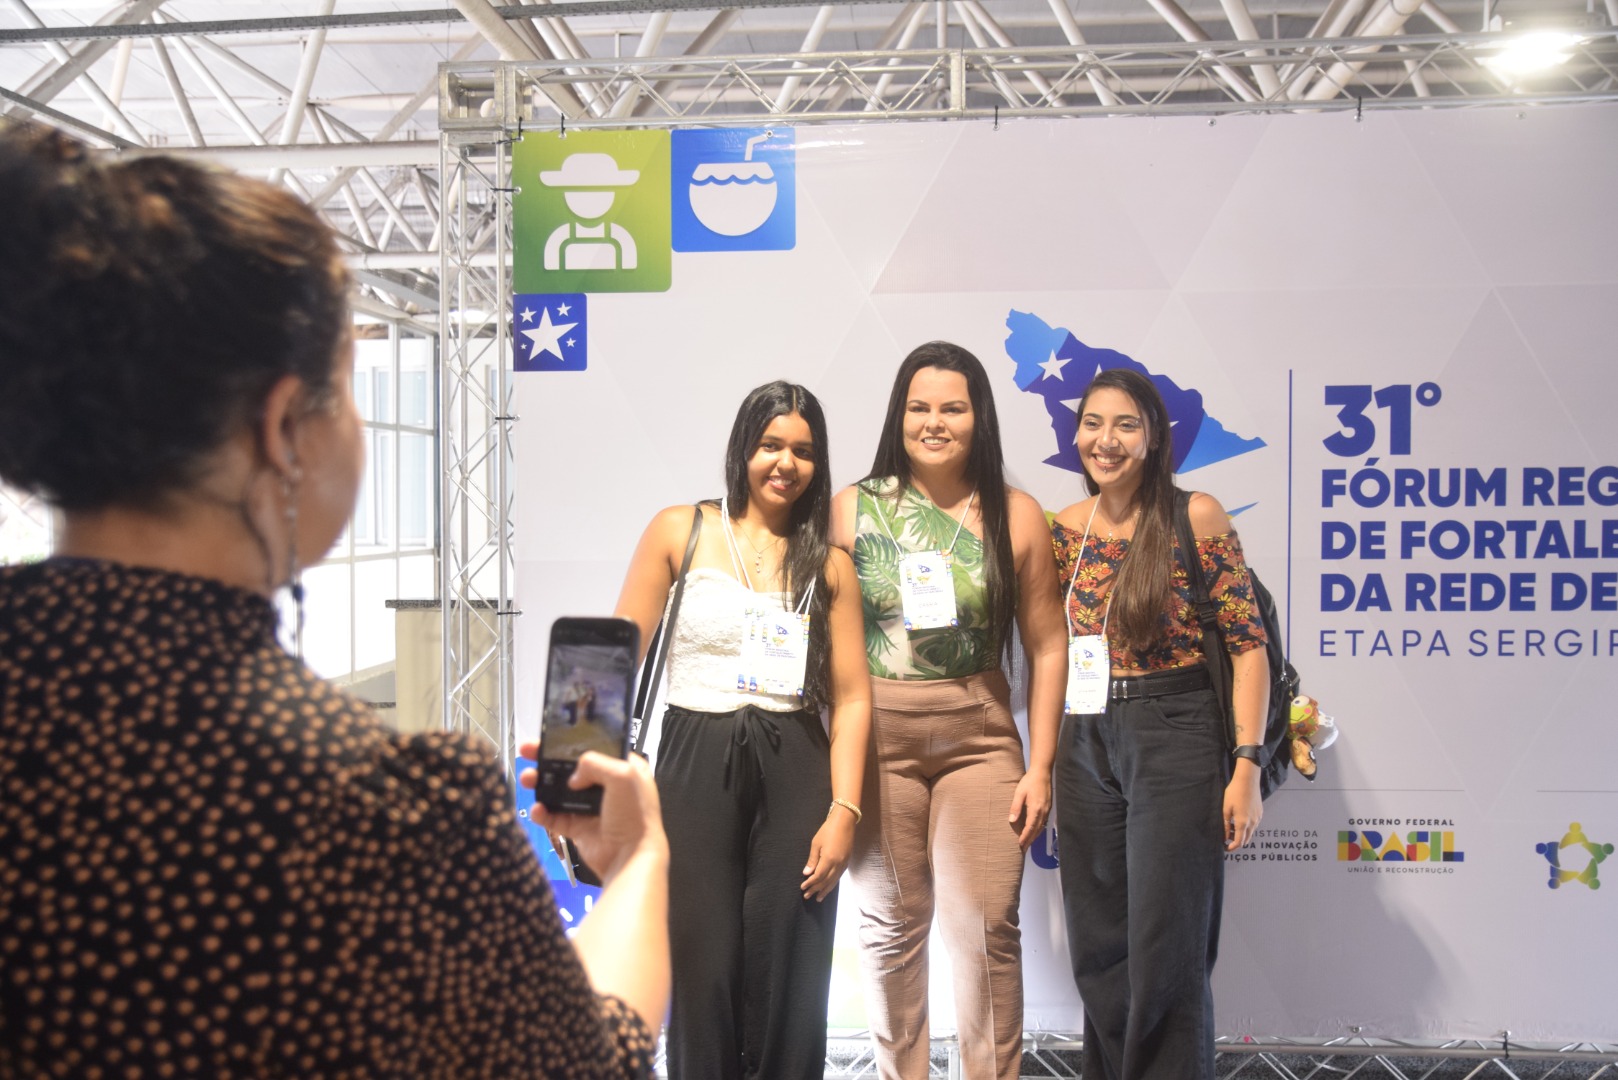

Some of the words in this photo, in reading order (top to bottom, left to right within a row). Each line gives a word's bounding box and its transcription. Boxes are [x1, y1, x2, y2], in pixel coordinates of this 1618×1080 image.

[1322, 381, 1442, 457] 31°
[1321, 457, 1507, 508] FÓRUM
[1522, 466, 1618, 506] REG
[1321, 521, 1386, 560] DE
[1400, 520, 1618, 560] FORTALE
[1320, 573, 1392, 612] DA
[1405, 573, 1536, 611] REDE
[1551, 572, 1618, 611] DE
[1320, 630, 1450, 656] ETAPA
[1252, 828, 1299, 838] ISTÉRIO
[1303, 830, 1318, 838] DA
[1348, 818, 1401, 826] GOVERNO
[1406, 818, 1455, 826] FEDERAL
[1260, 840, 1318, 851] INOVAÇÃO
[1261, 852, 1318, 861] PÚBLICOS
[1337, 830, 1464, 862] BRASIL
[1385, 867, 1454, 875] RECONSTRUÇÃO
